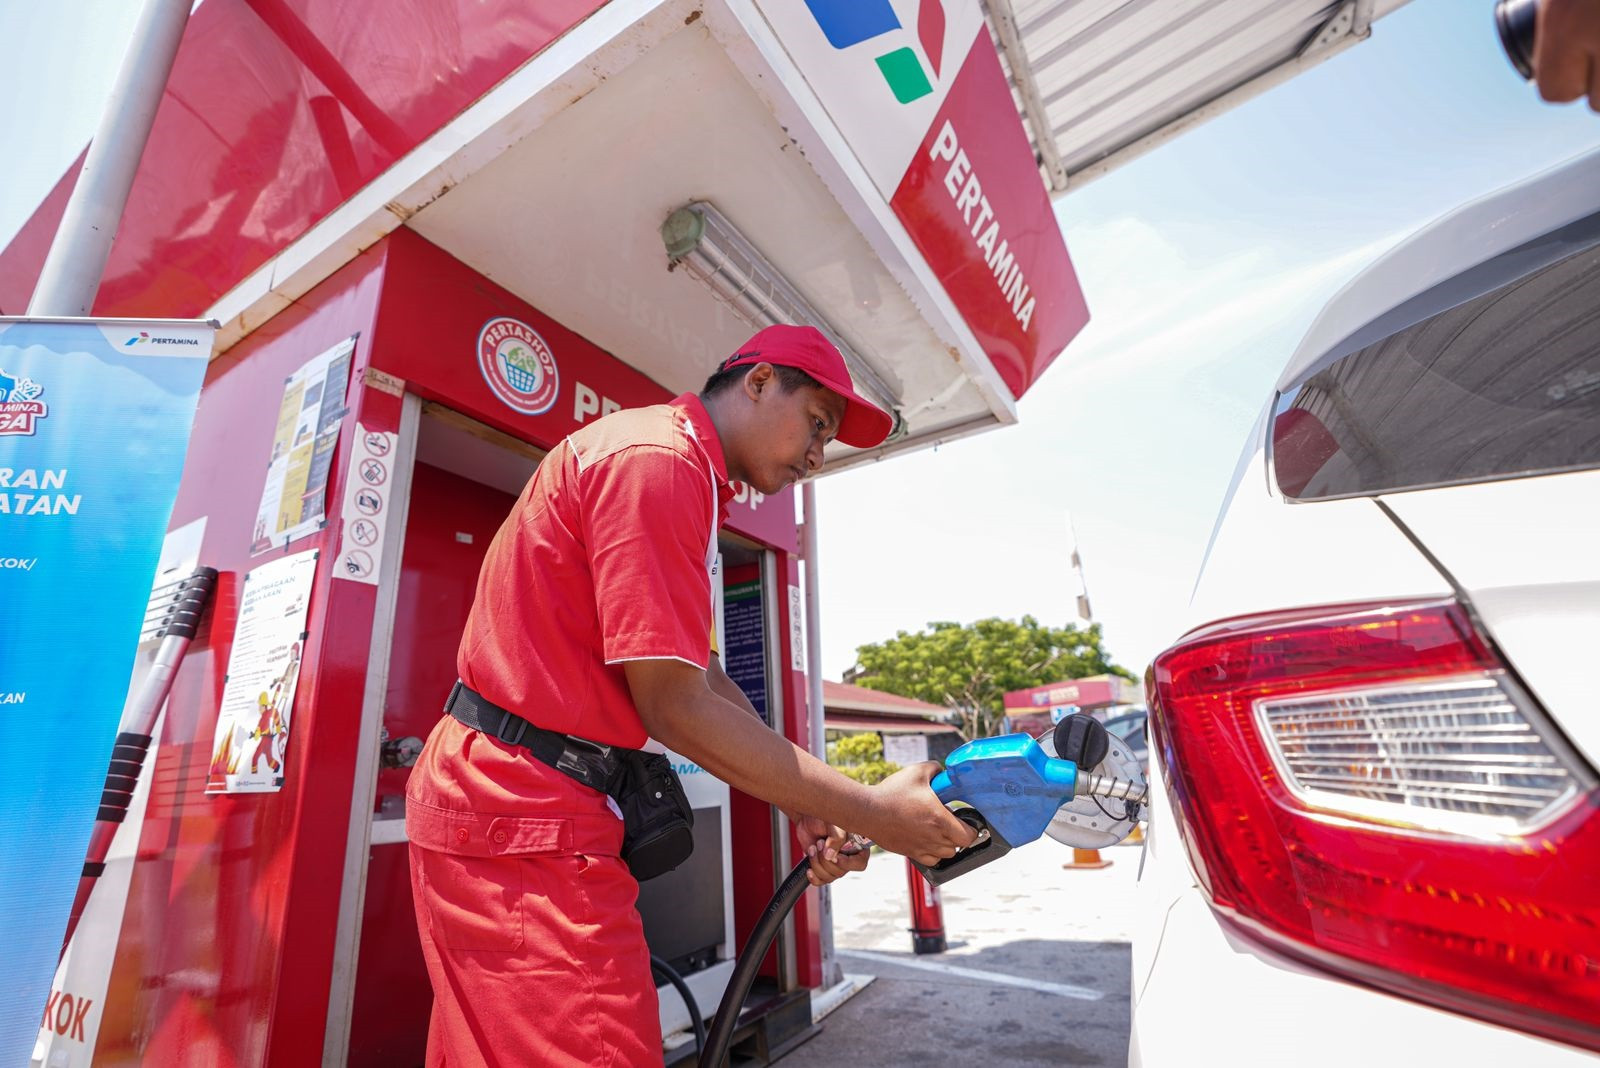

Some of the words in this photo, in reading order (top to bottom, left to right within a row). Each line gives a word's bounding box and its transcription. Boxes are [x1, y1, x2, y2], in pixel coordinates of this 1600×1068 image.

[929, 119, 1036, 332] PERTAMINA
[151, 337, 199, 346] PERTAMINA
[485, 323, 554, 376] PERTASHOP
[41, 990, 92, 1042] KOK
